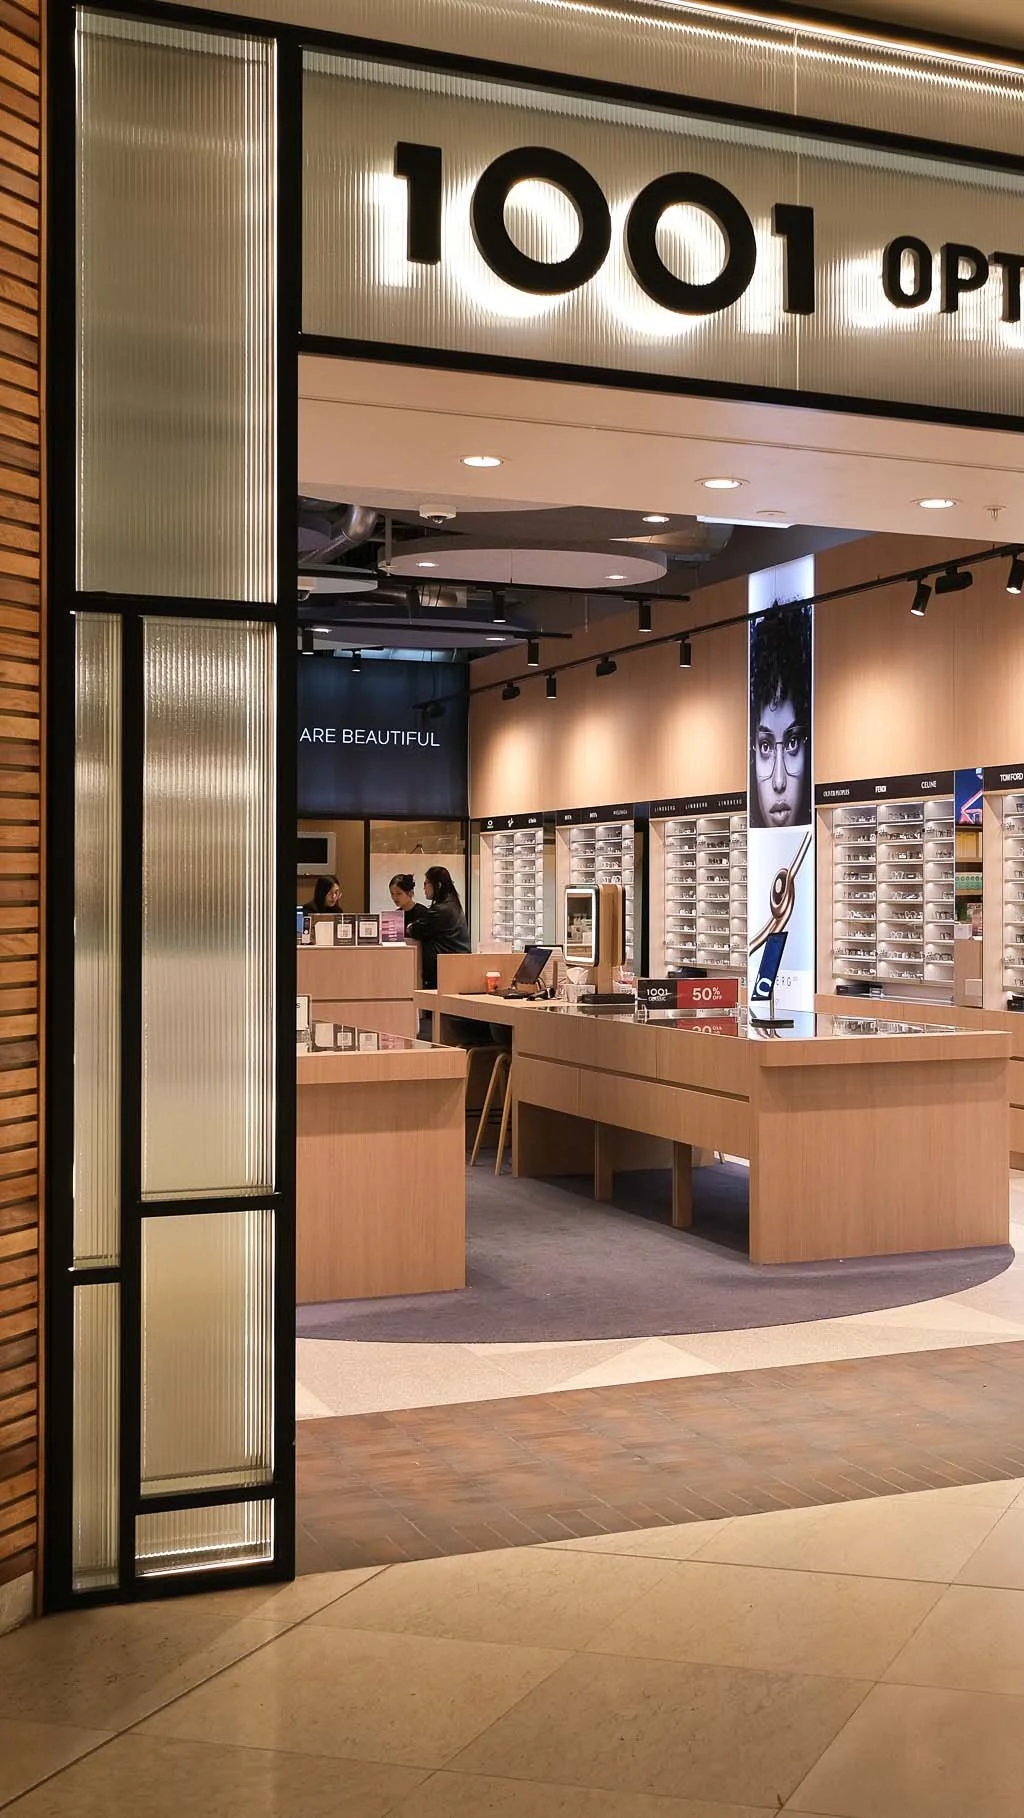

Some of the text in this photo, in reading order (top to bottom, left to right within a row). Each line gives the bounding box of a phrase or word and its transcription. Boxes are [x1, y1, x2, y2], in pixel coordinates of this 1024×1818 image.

[394, 140, 815, 317] 1001
[299, 727, 441, 747] ARE BEAUTIFUL
[920, 780, 937, 789] CELINE
